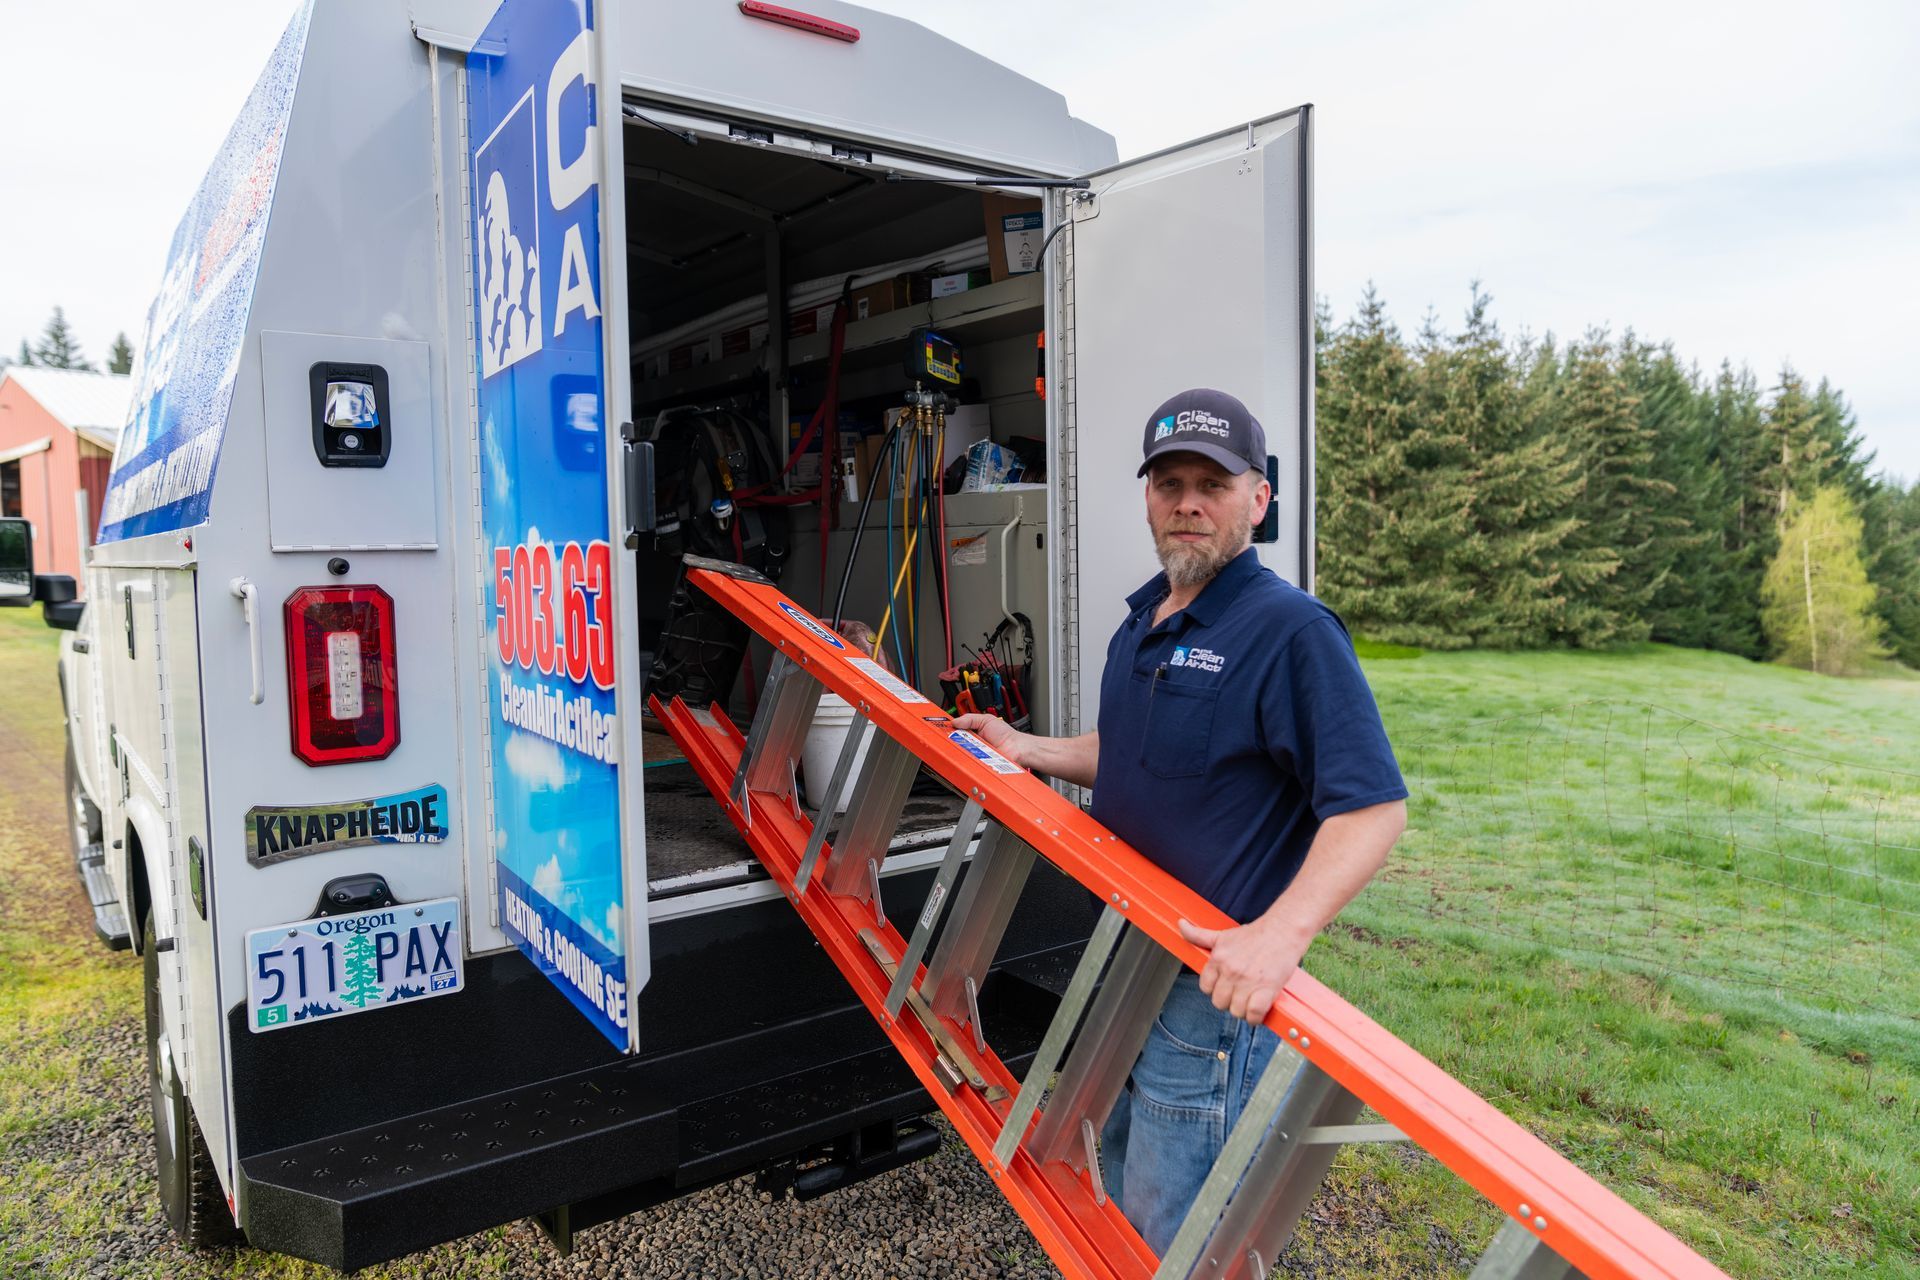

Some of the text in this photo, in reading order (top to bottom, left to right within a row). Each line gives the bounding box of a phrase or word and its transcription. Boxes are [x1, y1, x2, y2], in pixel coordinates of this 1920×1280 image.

[553, 222, 602, 337] A
[1176, 409, 1230, 430] Clean
[494, 540, 616, 690] 503.63
[1188, 648, 1225, 665] Clean
[501, 671, 618, 765] CleanAirActHea
[256, 794, 441, 858] KNAPHEIDE
[316, 912, 397, 936] Oregon
[257, 920, 454, 1005] 511 PAX
[436, 978, 451, 990] 27
[505, 886, 628, 1029] HEATING & COOLING SE
[266, 1008, 279, 1024] 5
